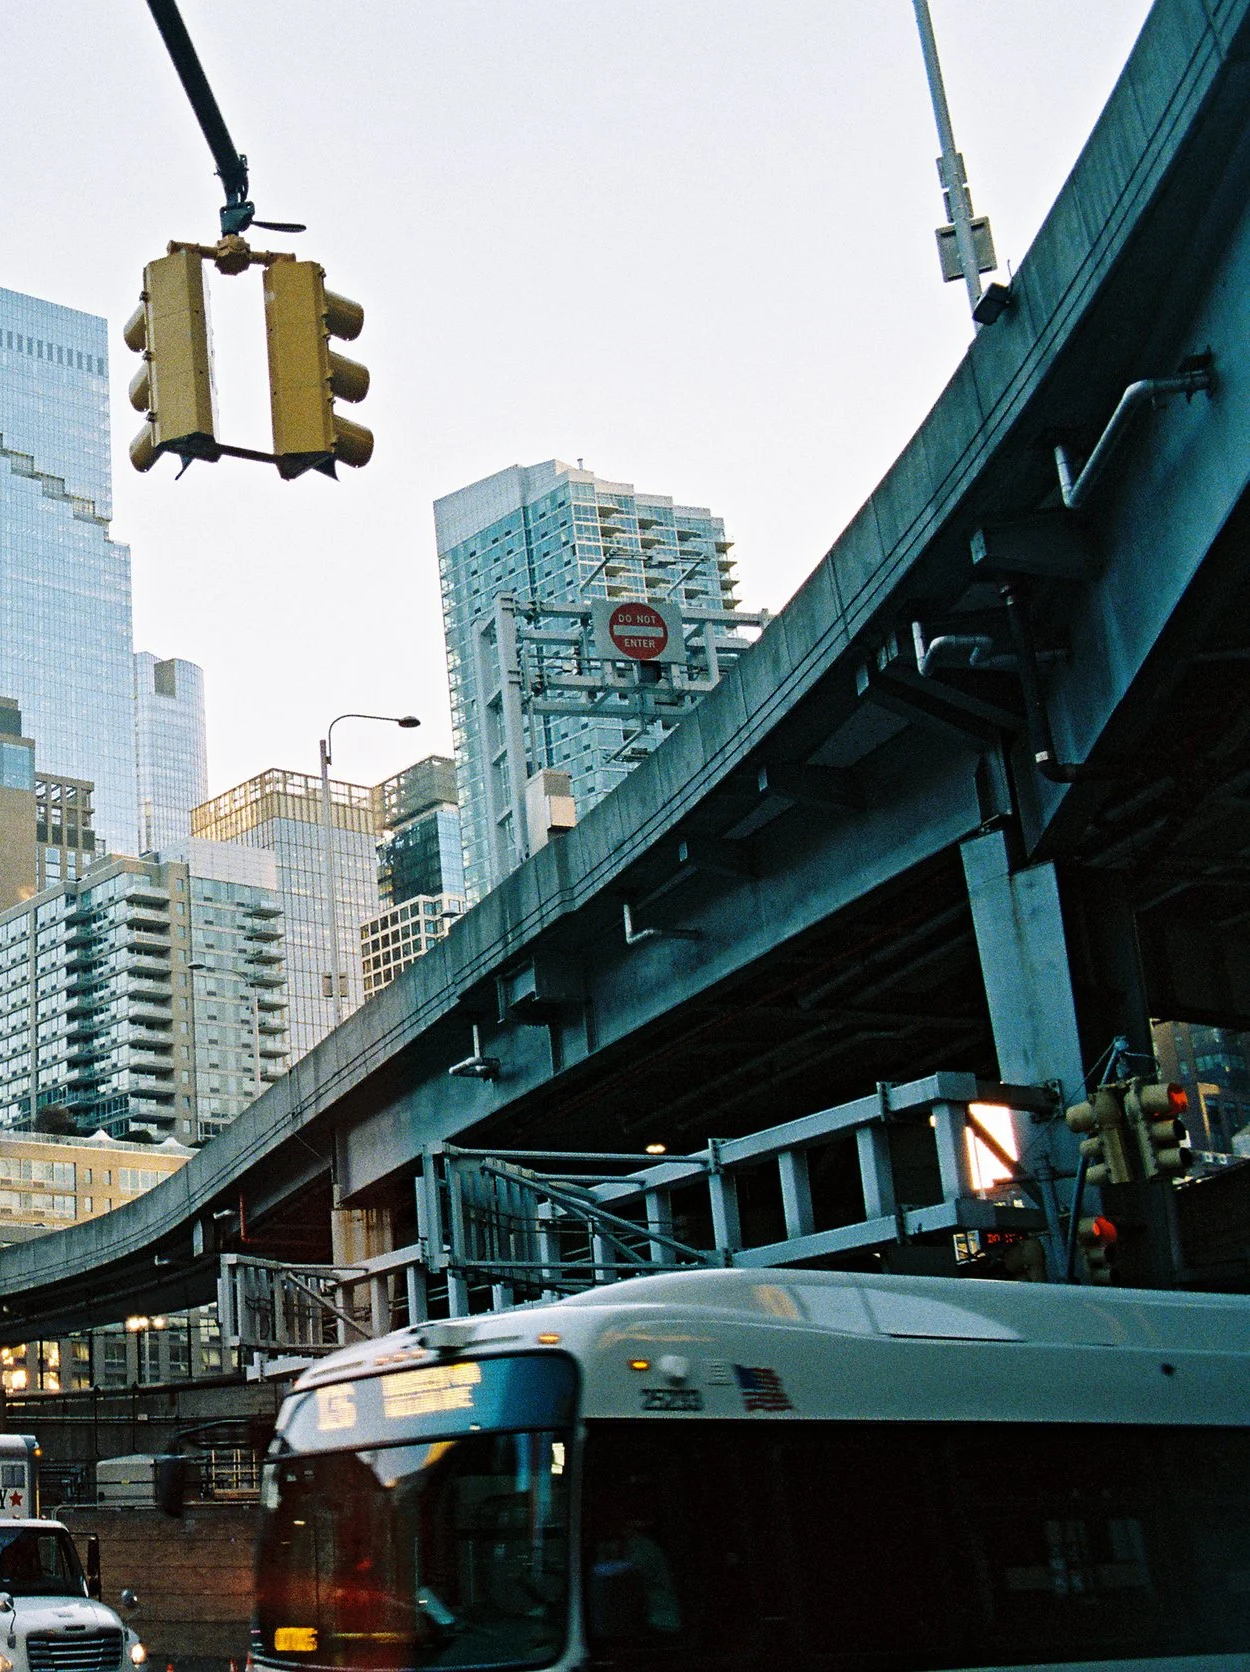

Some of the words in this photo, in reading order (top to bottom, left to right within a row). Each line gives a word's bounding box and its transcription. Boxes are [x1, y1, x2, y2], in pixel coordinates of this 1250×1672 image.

[618, 614, 632, 623] DO
[636, 615, 656, 624] NOT
[624, 638, 655, 648] ENTER
